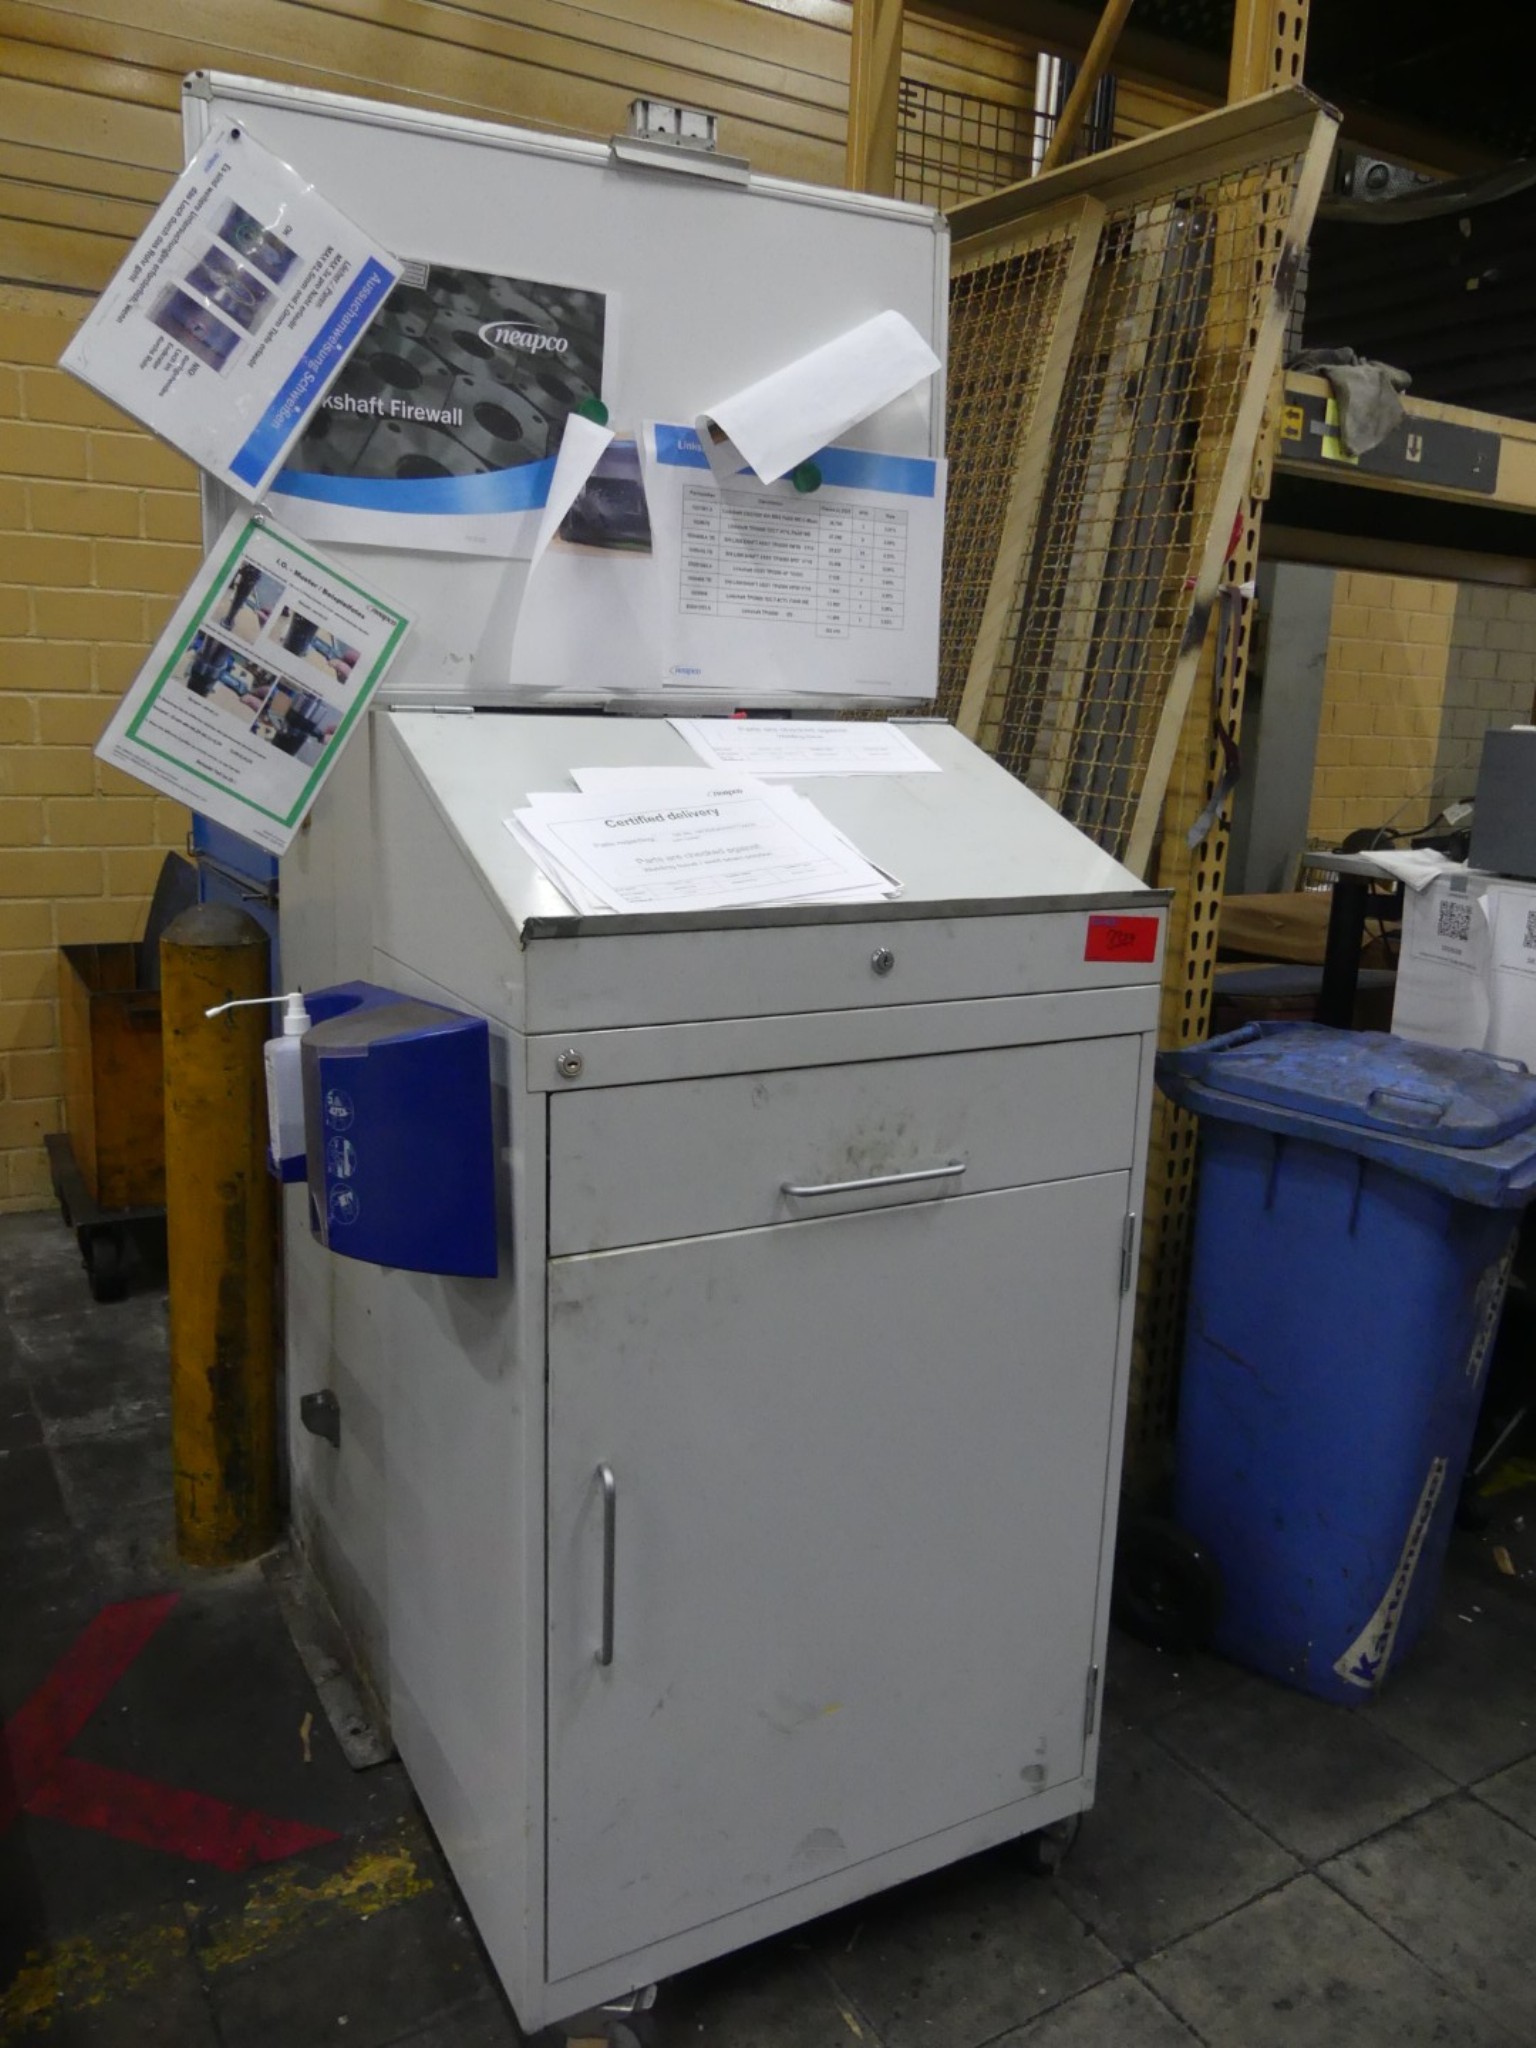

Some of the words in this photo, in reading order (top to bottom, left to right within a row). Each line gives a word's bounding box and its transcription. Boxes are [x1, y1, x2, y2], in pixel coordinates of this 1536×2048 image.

[173, 198, 190, 218] Loch
[138, 247, 156, 268] Rohr
[306, 272, 381, 373] Aussuchanweisung
[493, 326, 569, 354] neapco
[269, 371, 315, 430] Schweißen
[390, 400, 464, 427] Firewall
[604, 812, 666, 829] Certified
[667, 807, 720, 821] delivery
